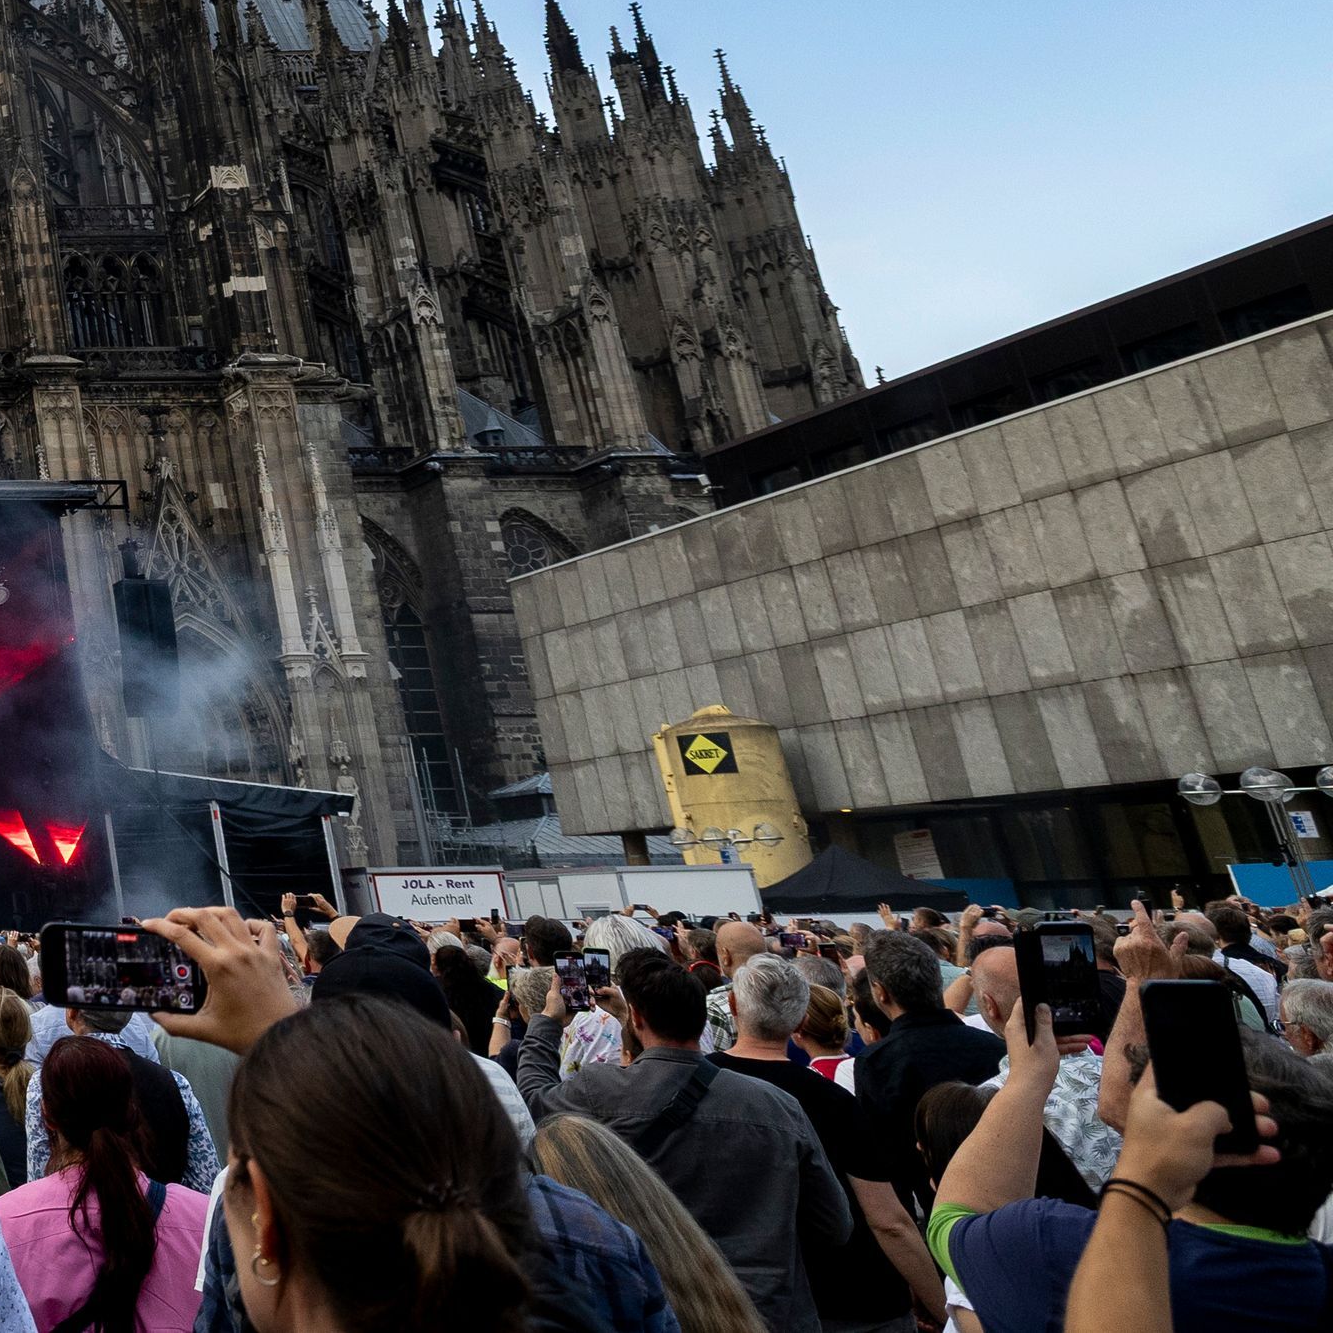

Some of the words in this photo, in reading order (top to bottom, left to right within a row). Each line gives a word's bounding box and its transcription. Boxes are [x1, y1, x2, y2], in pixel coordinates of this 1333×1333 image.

[401, 879, 435, 889] JOLA
[446, 879, 475, 889] Rent
[411, 894, 474, 905] Aufenthalt
